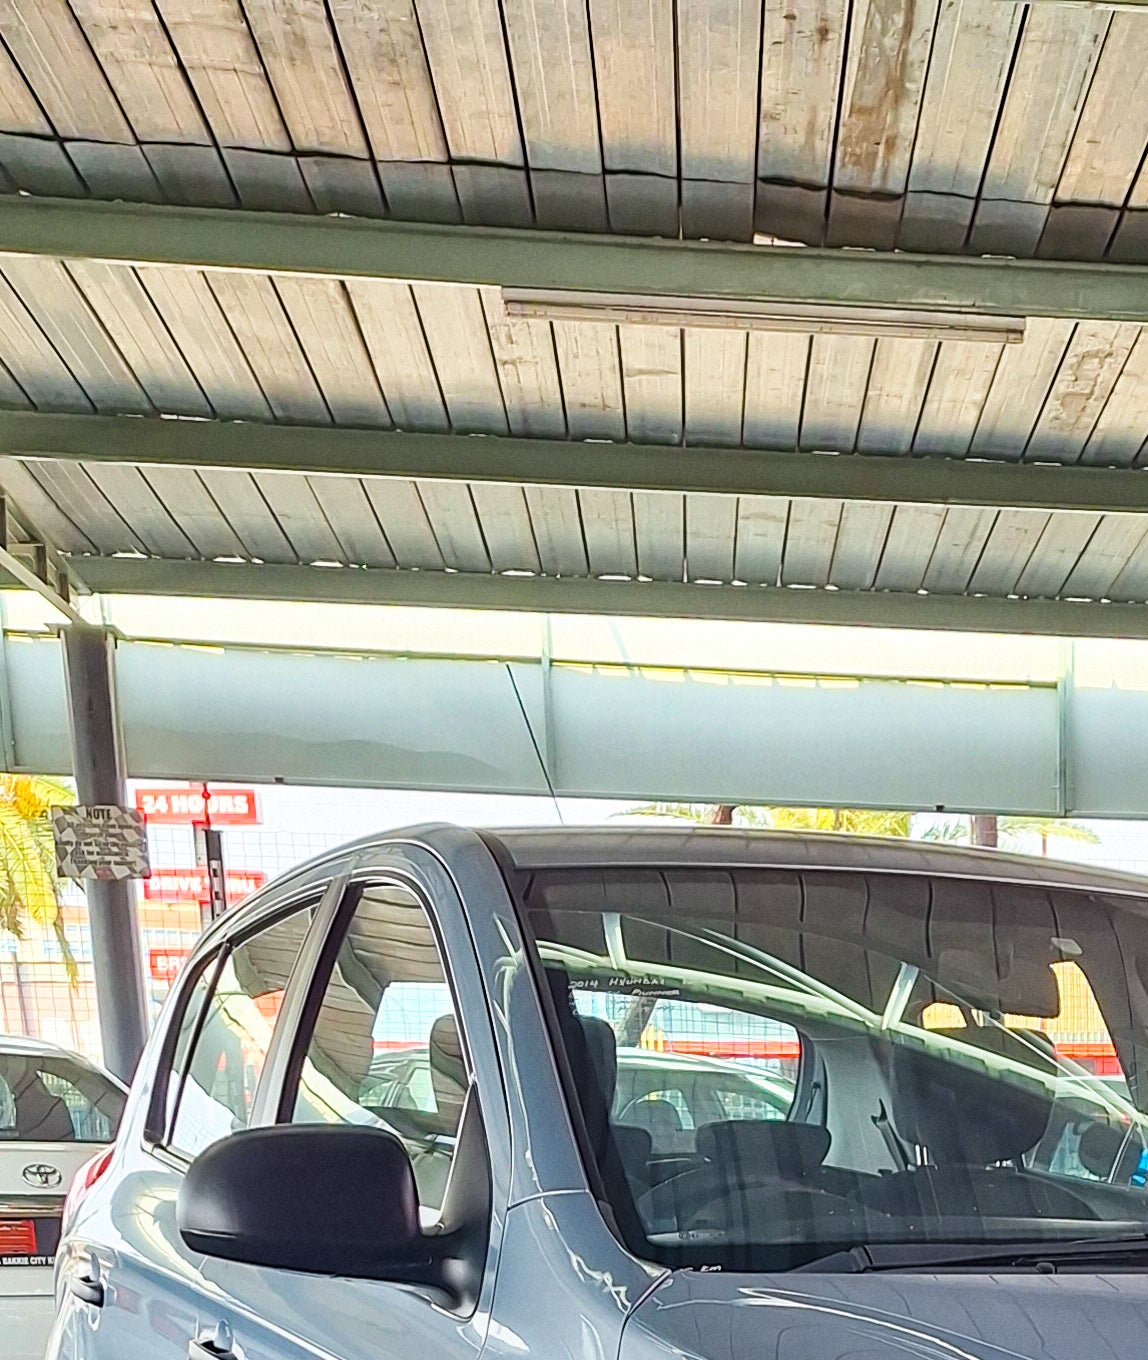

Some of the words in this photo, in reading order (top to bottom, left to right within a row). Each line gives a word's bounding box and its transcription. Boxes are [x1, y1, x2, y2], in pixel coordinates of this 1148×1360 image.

[142, 795, 168, 814] 24
[171, 795, 249, 814] HOURS
[86, 808, 111, 820] NOTE
[151, 876, 202, 892] DRIVE
[568, 980, 599, 990] 2014
